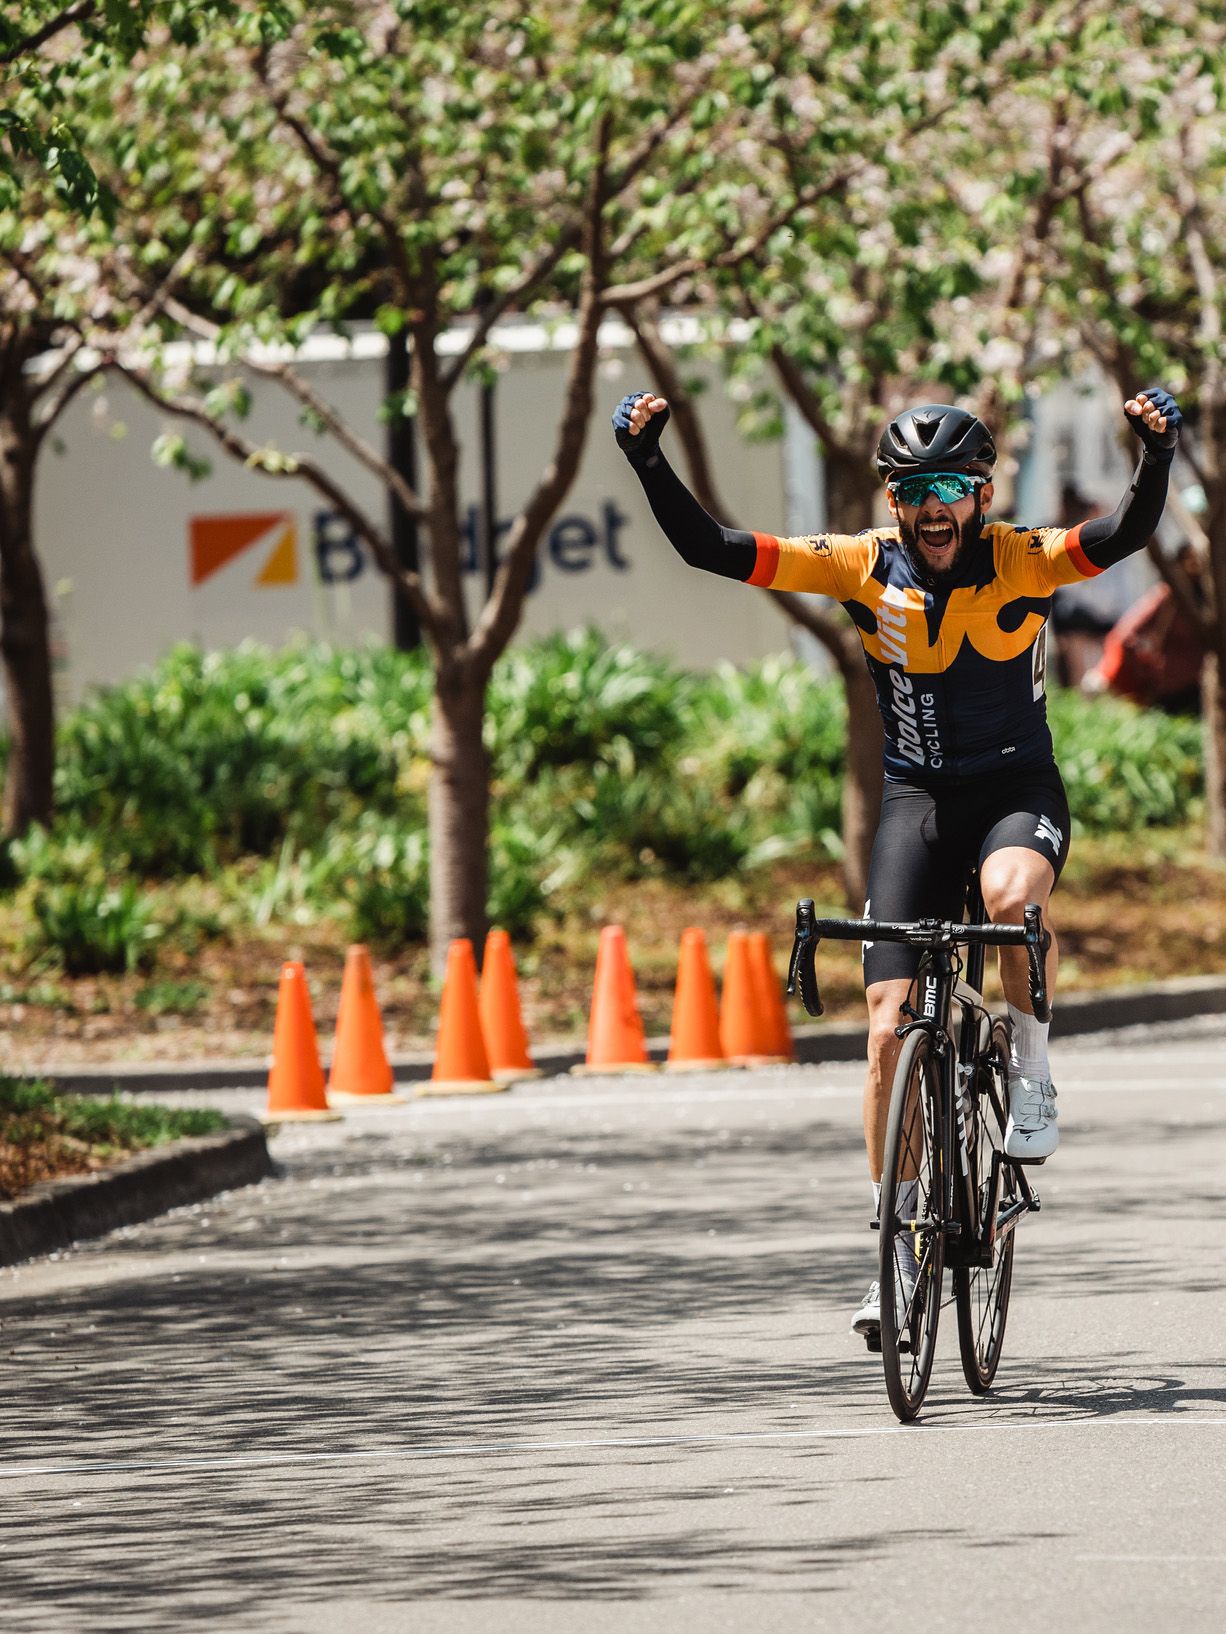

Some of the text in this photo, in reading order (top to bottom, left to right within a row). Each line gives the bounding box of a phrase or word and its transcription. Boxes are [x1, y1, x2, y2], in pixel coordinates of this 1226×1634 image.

[314, 500, 628, 593] Bdet
[877, 584, 926, 766] Dolce Vit
[921, 692, 943, 769] CYCLING
[923, 975, 937, 1018] BMC
